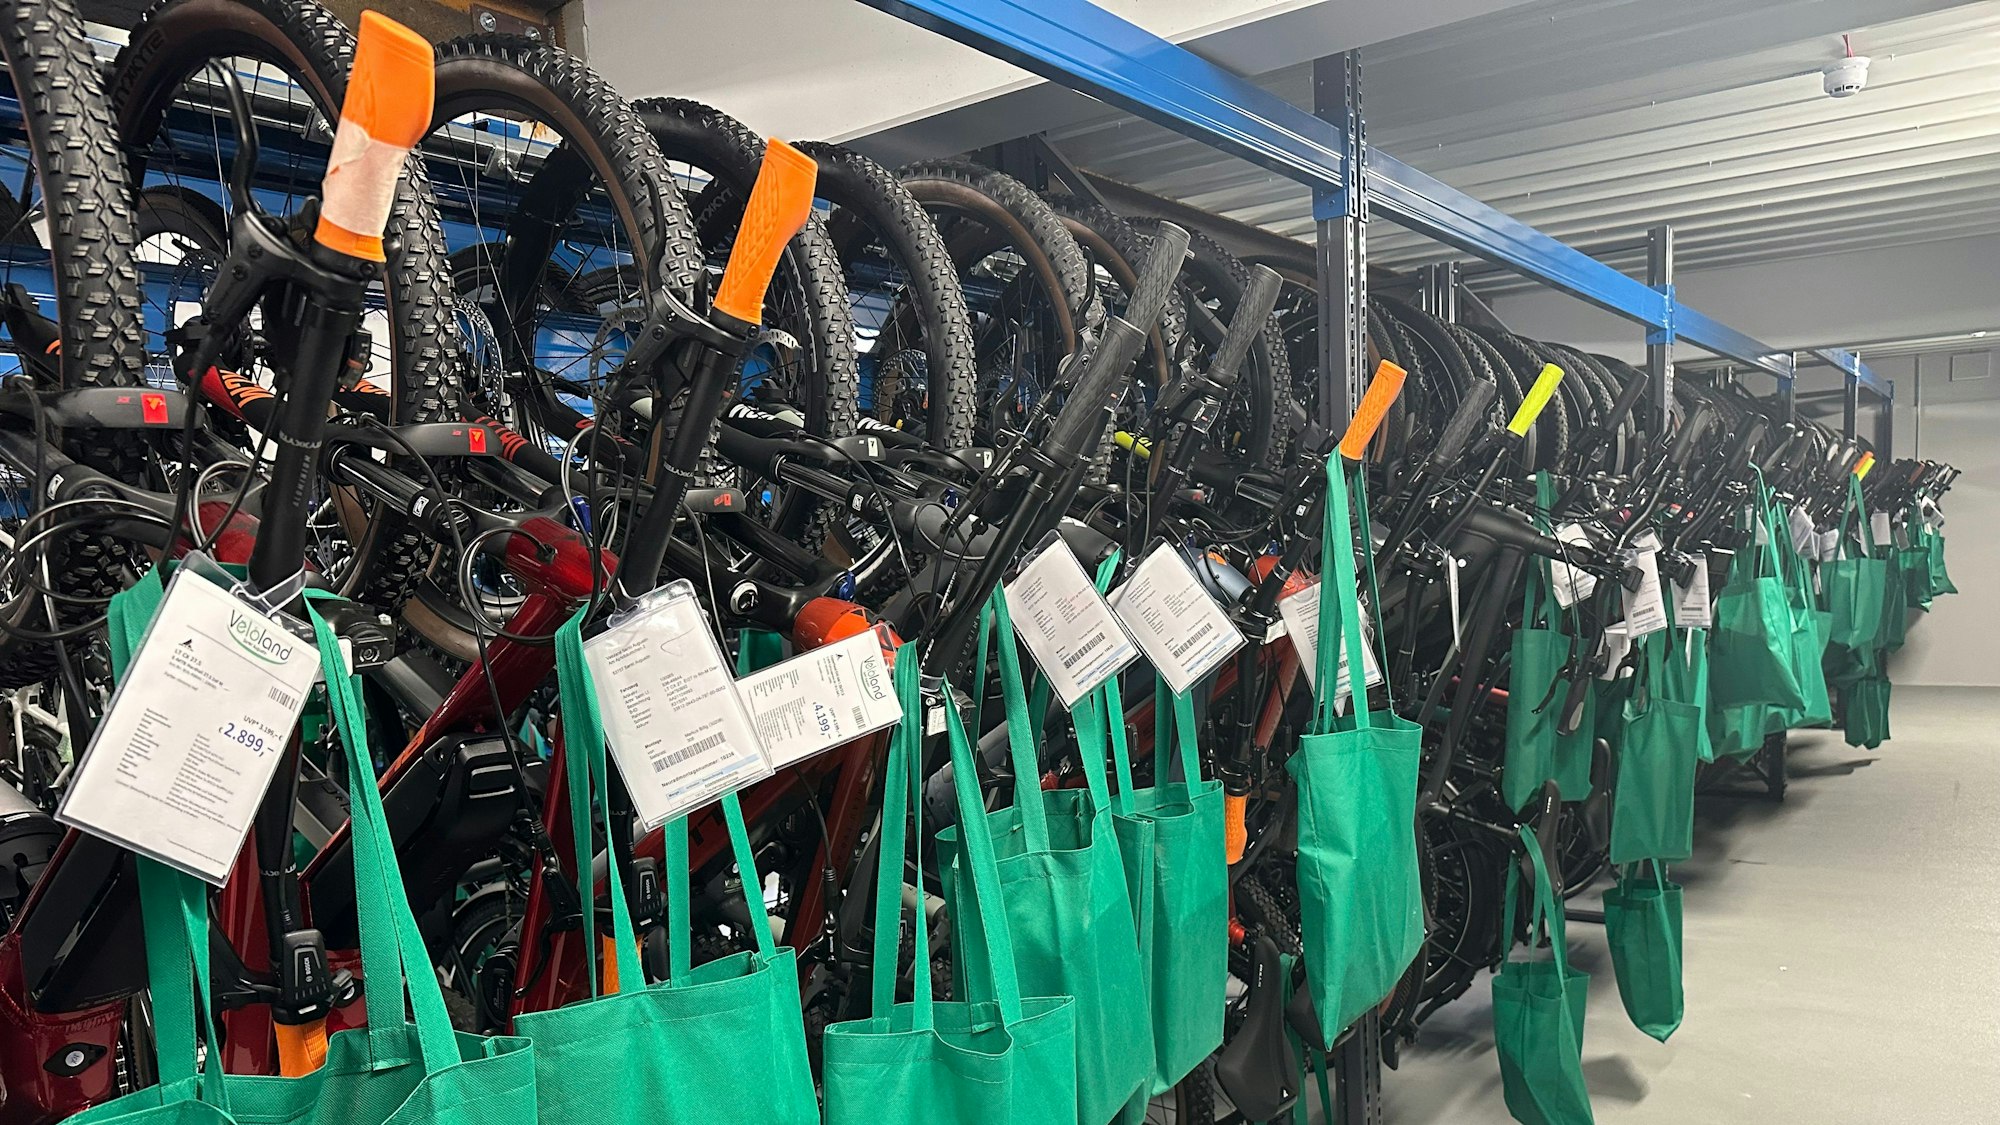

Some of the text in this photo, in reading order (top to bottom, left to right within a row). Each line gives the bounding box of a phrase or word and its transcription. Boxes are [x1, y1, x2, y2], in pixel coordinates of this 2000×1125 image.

[230, 610, 293, 660] Veloland
[864, 656, 886, 700] Veloland
[815, 705, 830, 738] 4.199,-
